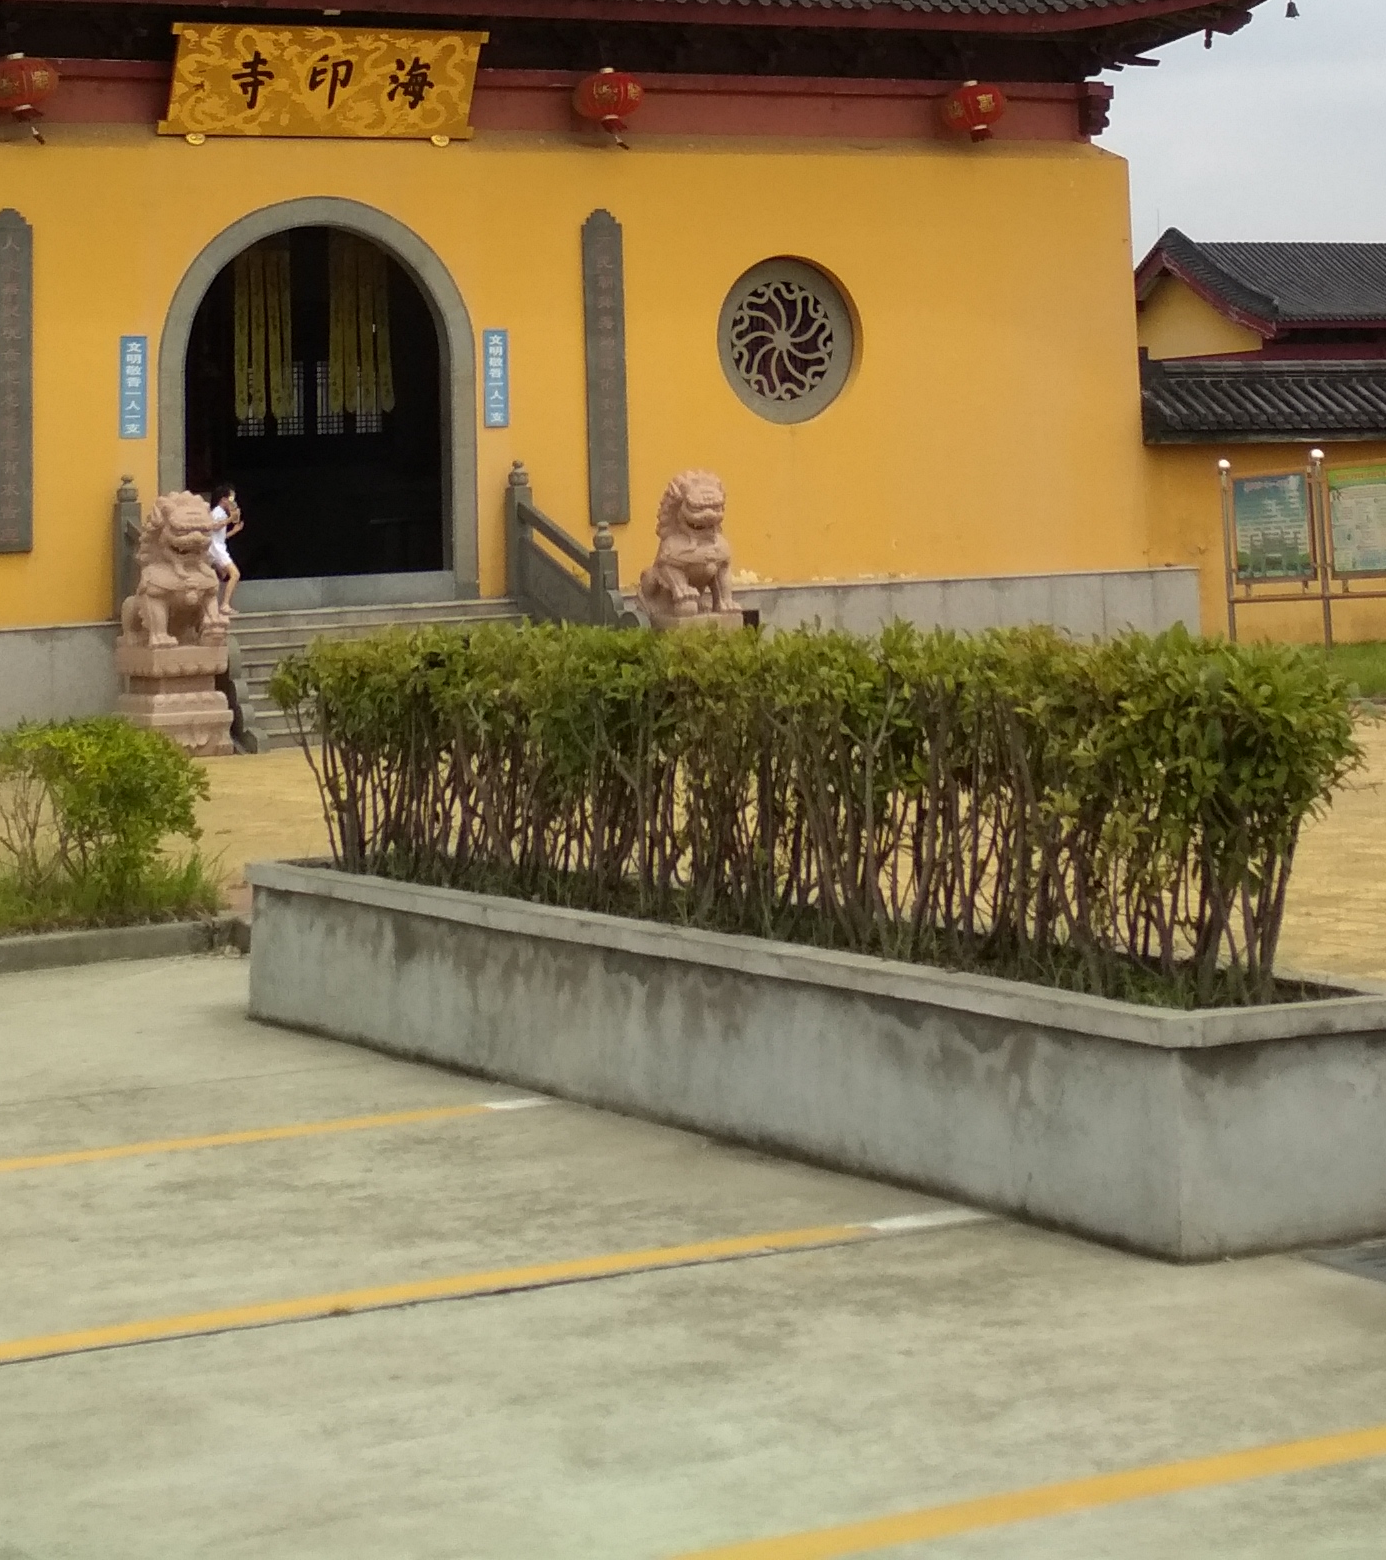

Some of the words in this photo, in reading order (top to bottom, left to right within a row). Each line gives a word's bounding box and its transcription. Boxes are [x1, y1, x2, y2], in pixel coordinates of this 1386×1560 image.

[231, 50, 434, 110] 海印寺
[124, 341, 143, 435] 文明敬香一人一支
[488, 334, 505, 423] 文明敬香一人一支
